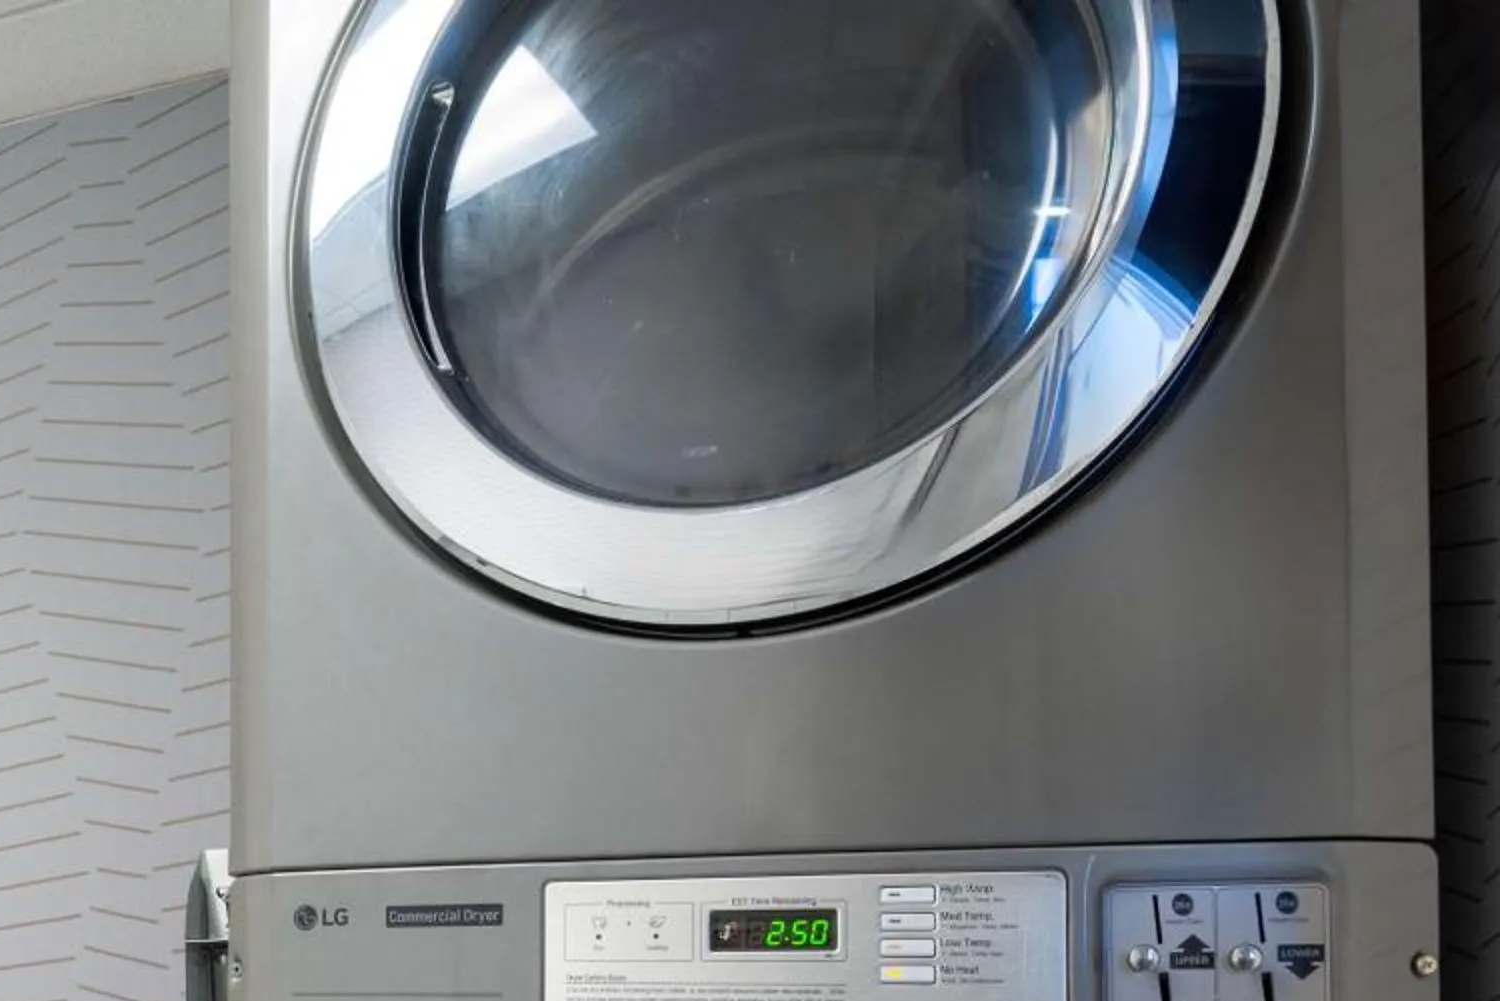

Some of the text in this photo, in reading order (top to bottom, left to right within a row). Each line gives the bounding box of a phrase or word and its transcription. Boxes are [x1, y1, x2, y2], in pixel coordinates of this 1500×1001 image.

[388, 908, 500, 924] Commercial Dryer
[1281, 948, 1320, 957] LOWER
